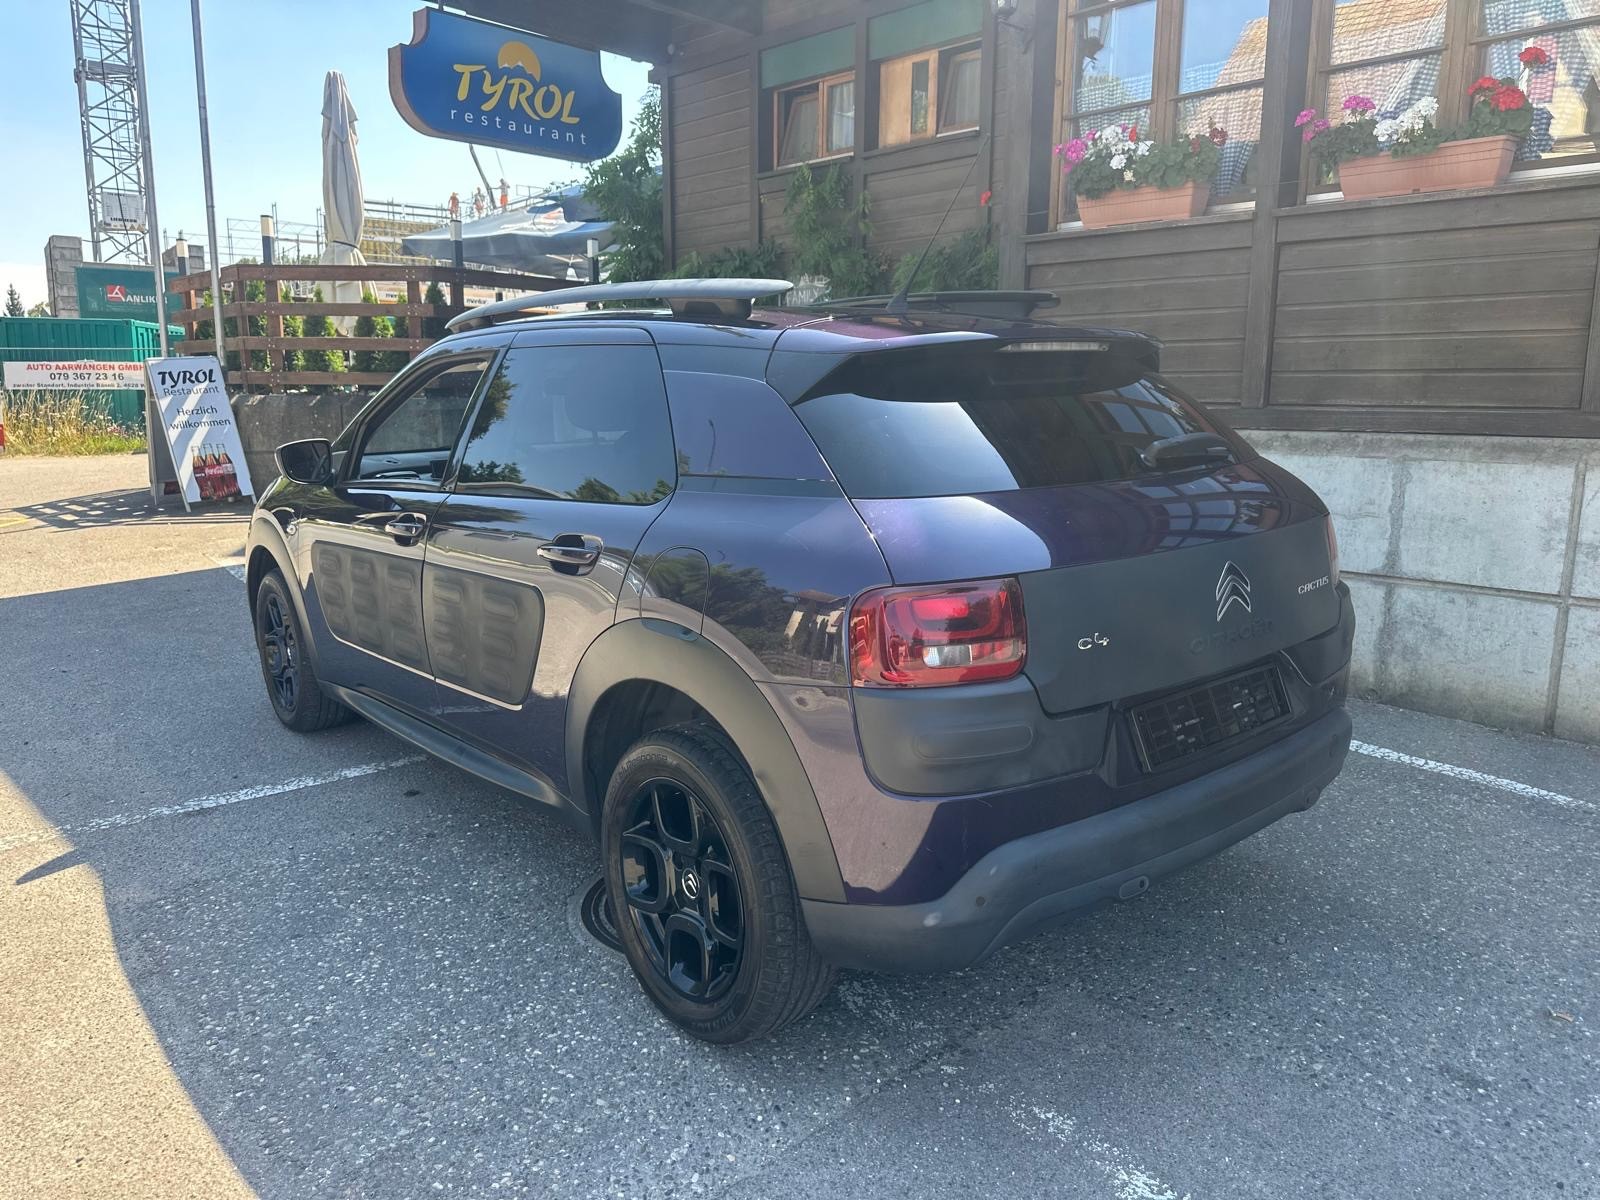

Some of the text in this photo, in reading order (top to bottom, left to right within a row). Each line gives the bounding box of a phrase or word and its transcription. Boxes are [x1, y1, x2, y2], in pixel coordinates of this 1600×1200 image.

[453, 63, 580, 124] TYROL
[450, 109, 586, 145] restaurant
[26, 363, 145, 371] AUTO AARWANGEN GMBH
[49, 372, 125, 380] 079 367 23 16
[157, 368, 217, 389] TYROL
[163, 385, 220, 396] Restaurant
[176, 405, 218, 416] Herzlich
[170, 418, 231, 430] willkommen
[1298, 575, 1329, 595] CACTUS
[1077, 632, 1110, 650] C4
